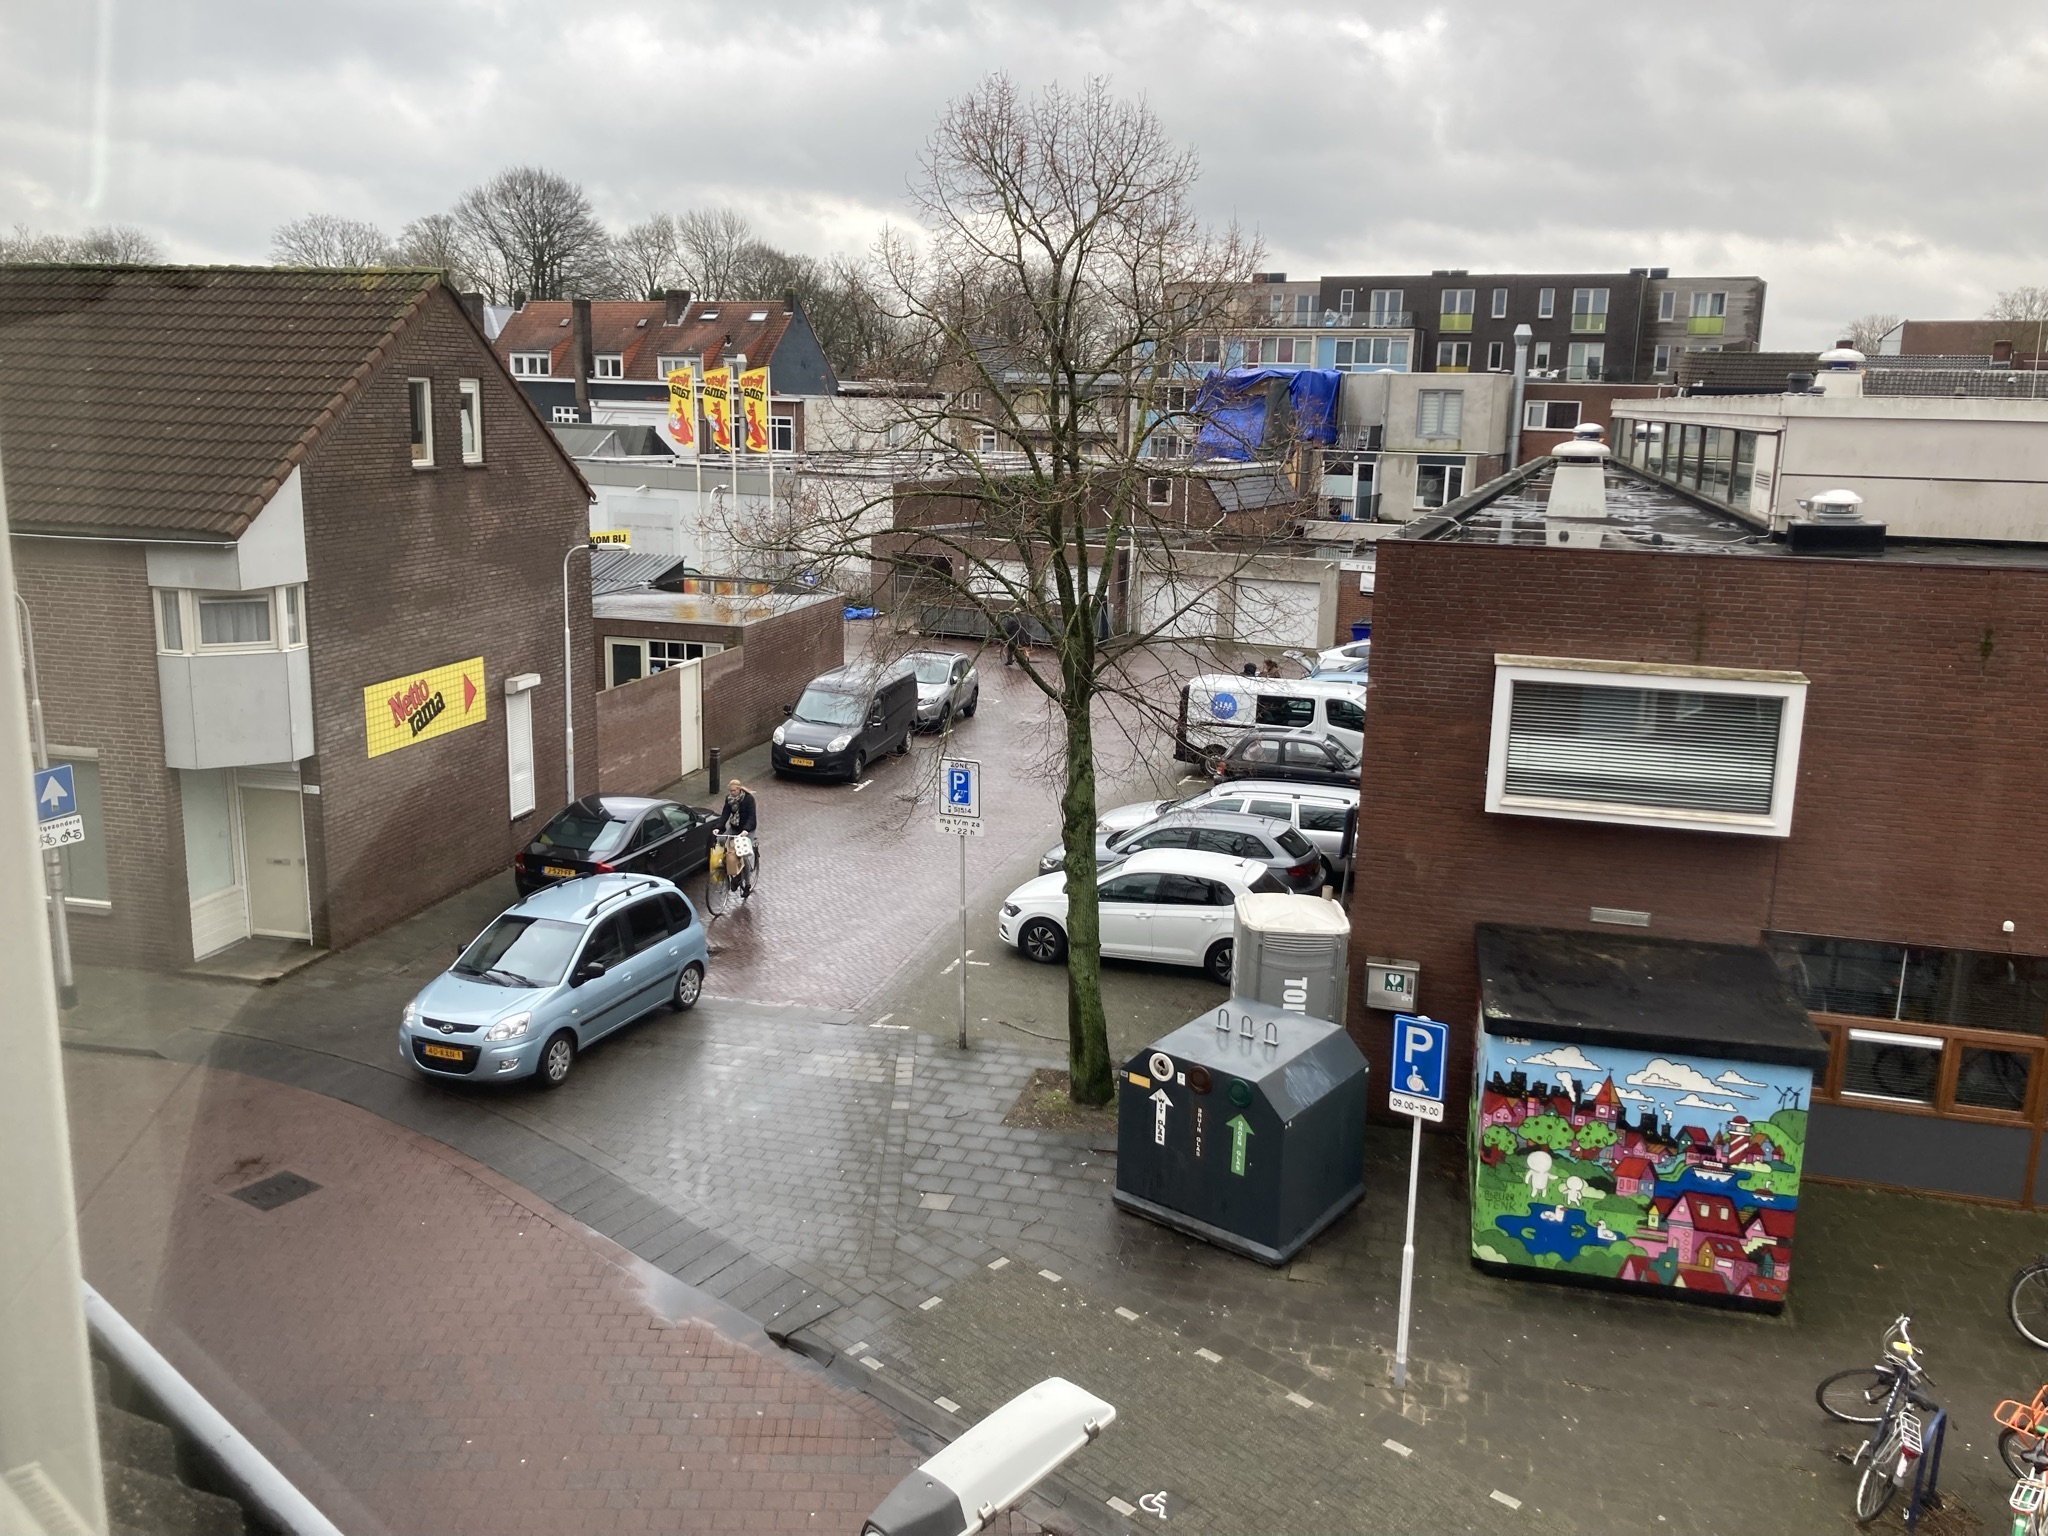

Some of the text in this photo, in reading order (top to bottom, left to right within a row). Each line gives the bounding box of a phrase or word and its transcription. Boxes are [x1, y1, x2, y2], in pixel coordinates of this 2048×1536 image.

[612, 534, 627, 544] BIJ
[388, 679, 430, 729] Netto
[407, 691, 446, 738] rama
[953, 772, 966, 790] P
[1282, 976, 1308, 1015] TOI
[1404, 1025, 1434, 1063] P
[1157, 1097, 1165, 1114] WIT
[1236, 1120, 1244, 1146] GROEN
